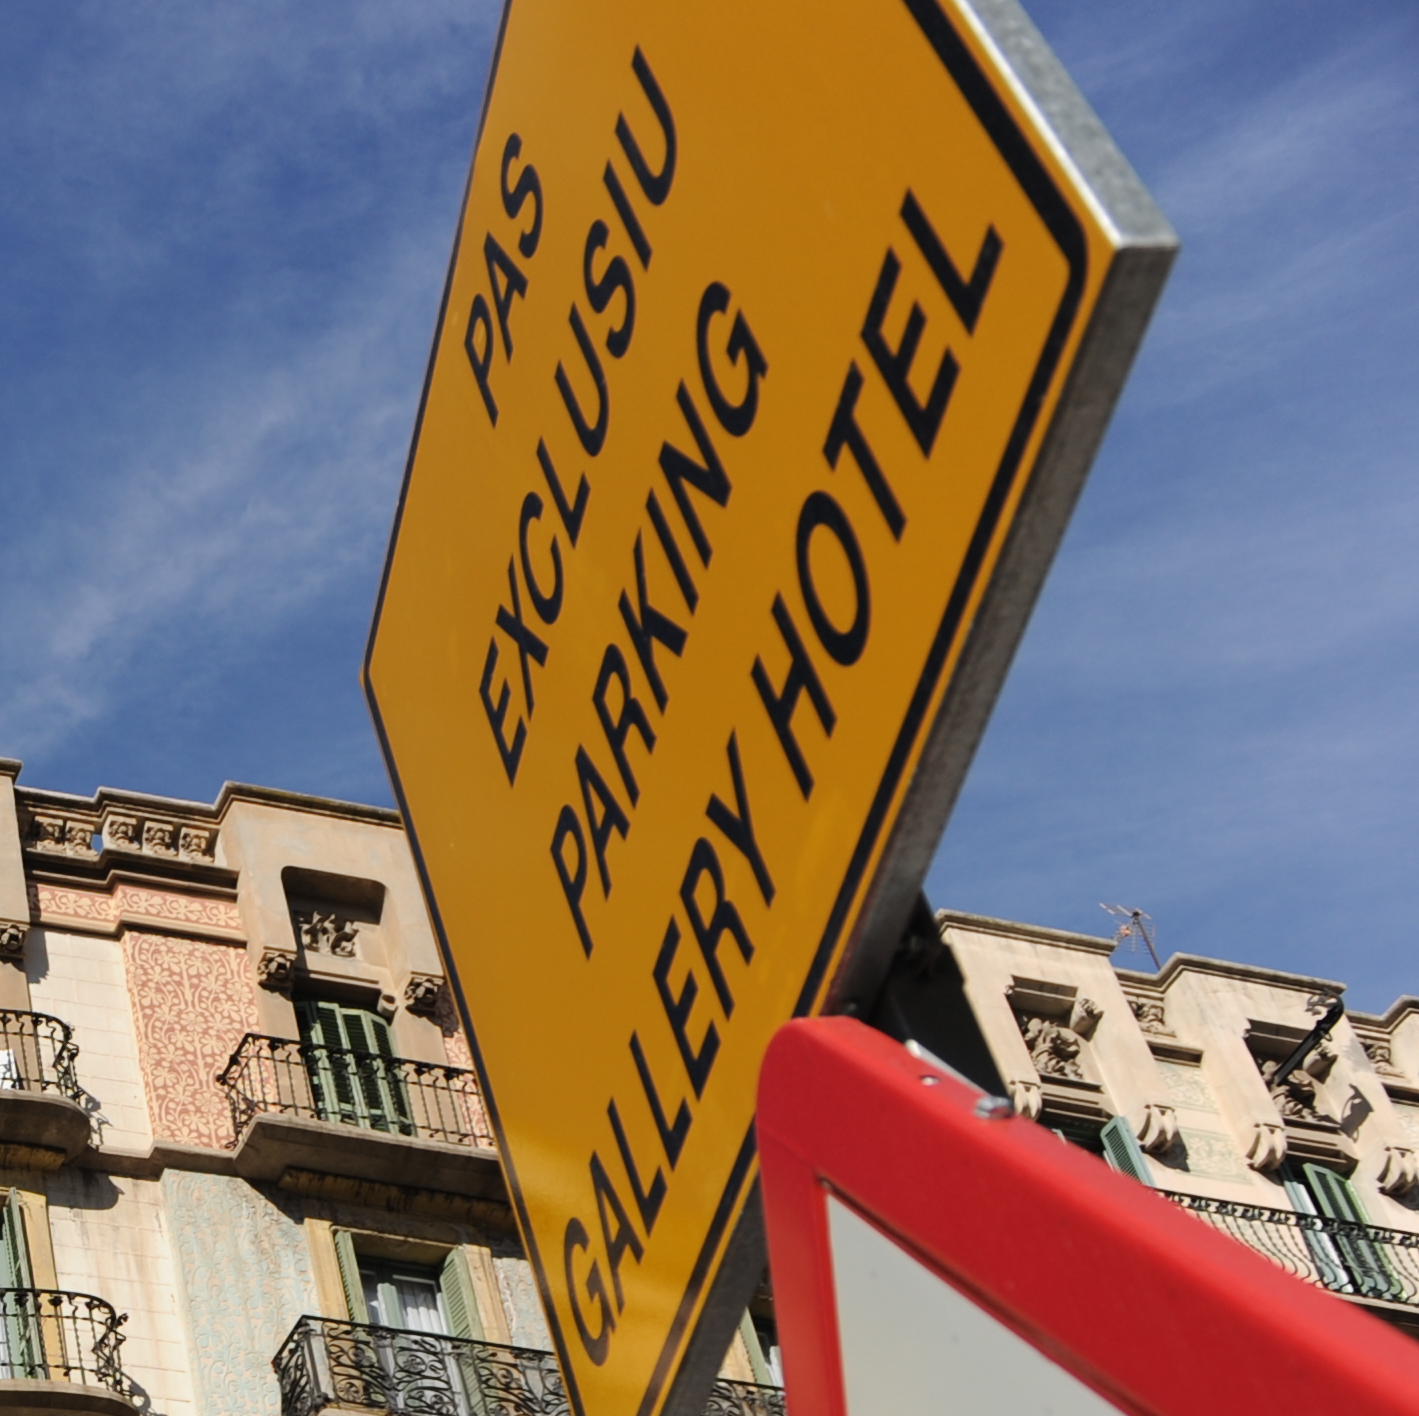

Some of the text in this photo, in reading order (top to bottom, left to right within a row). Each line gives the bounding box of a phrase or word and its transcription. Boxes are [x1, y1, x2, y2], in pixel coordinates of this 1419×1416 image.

[464, 133, 544, 427] PAS
[478, 46, 678, 786] EXCLUSIU
[549, 281, 768, 959] PARKING
[564, 190, 1003, 1366] GALLERY HOTEL
